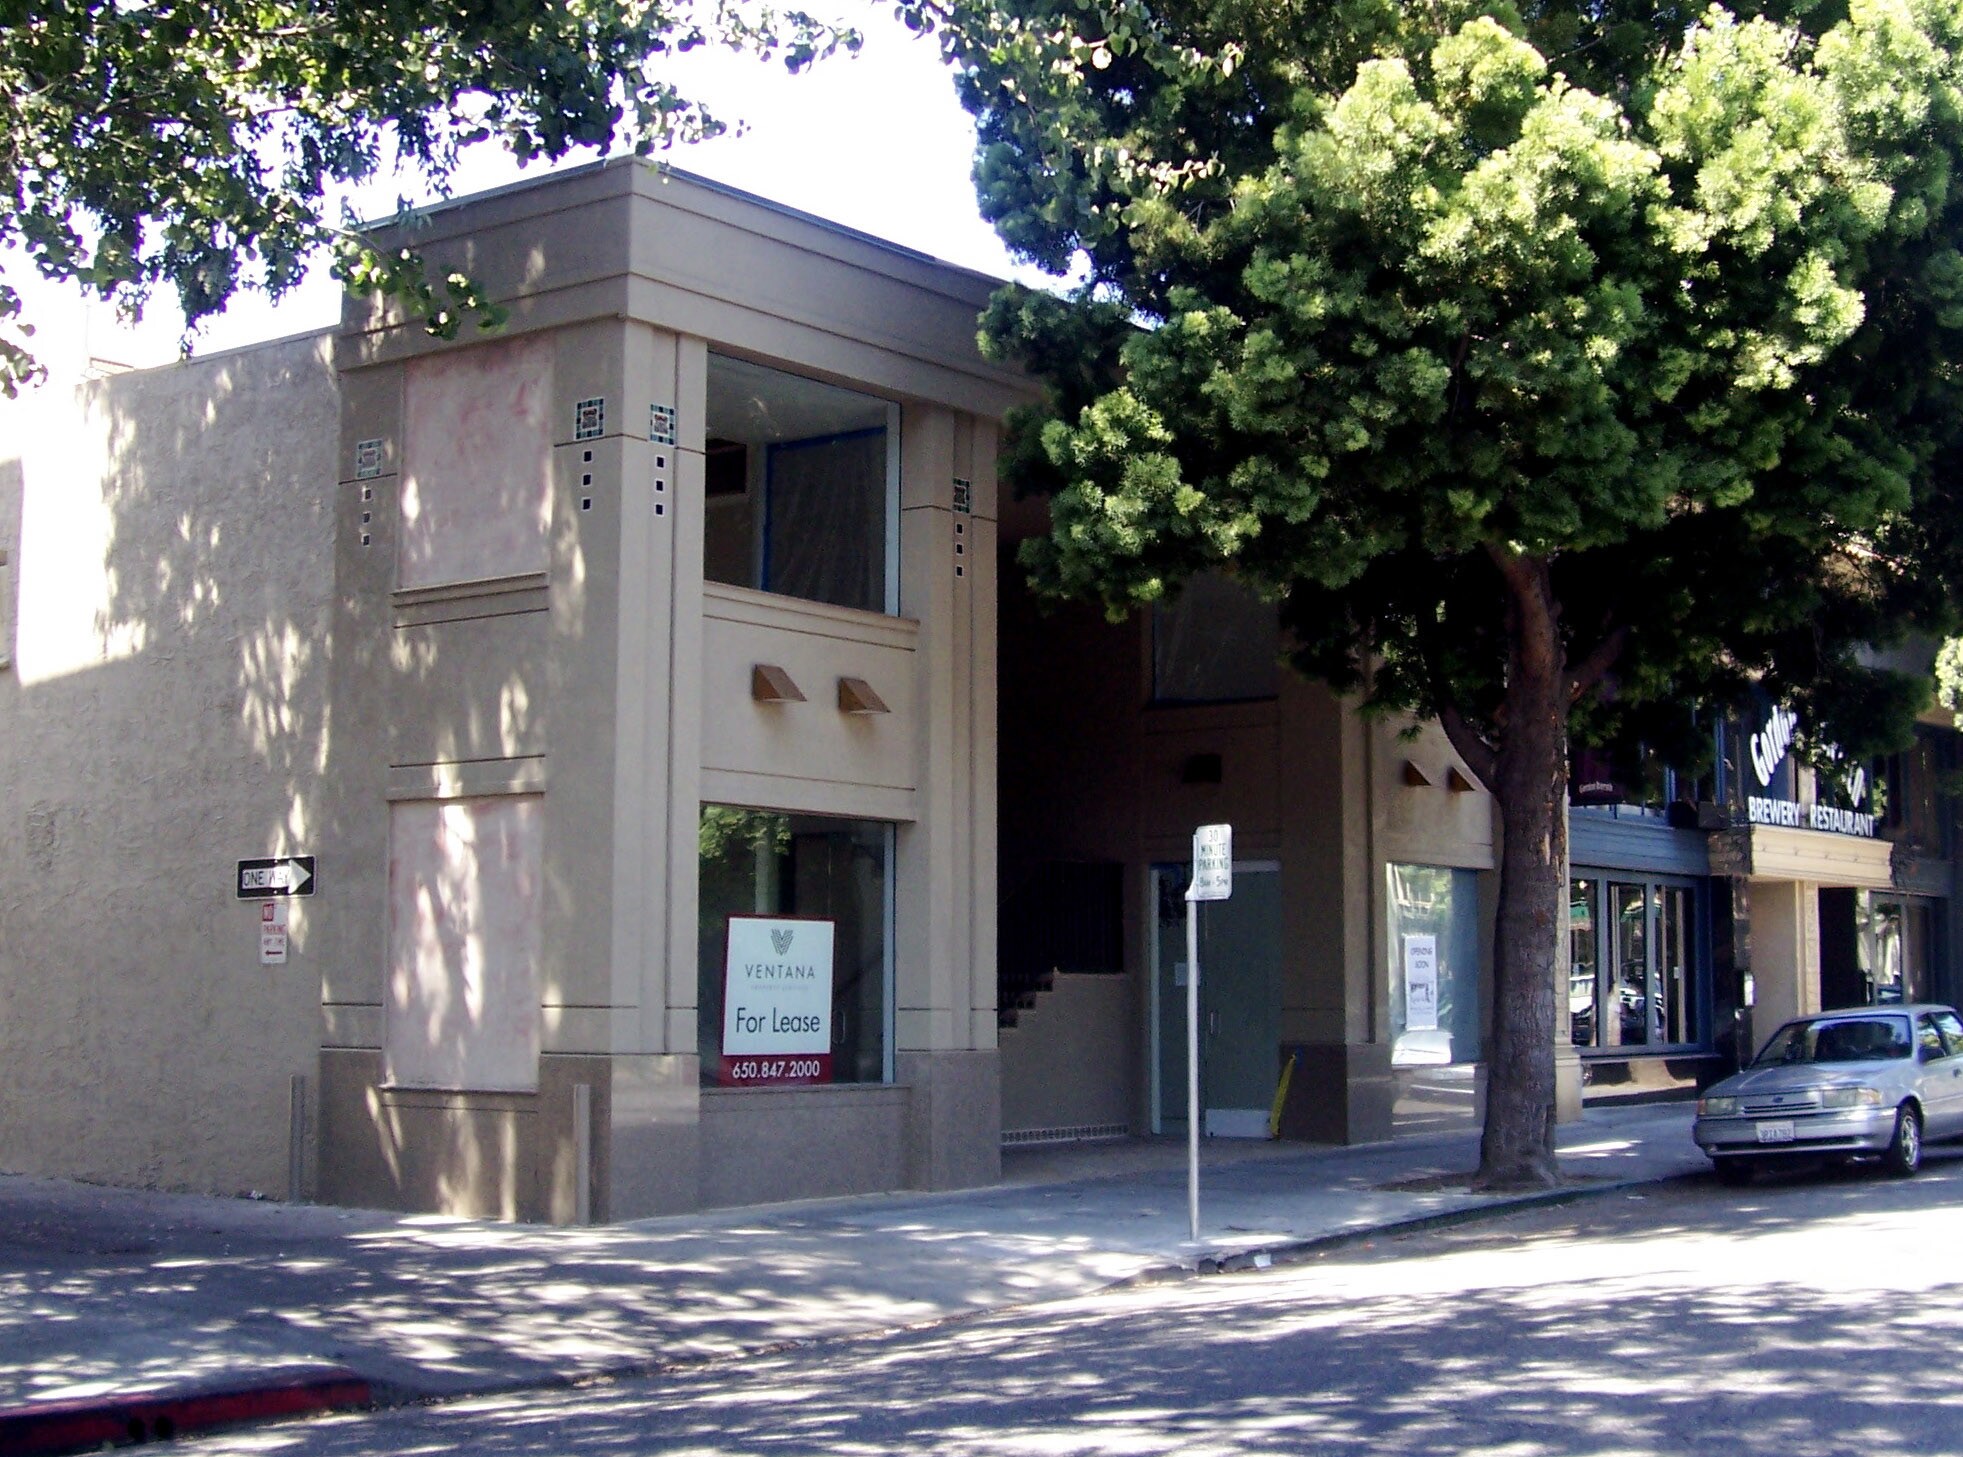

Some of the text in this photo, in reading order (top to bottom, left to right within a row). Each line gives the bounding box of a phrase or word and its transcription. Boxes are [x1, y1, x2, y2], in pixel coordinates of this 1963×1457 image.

[1749, 796, 1874, 837] BREWERY RESTAURANT
[1208, 829, 1219, 842] 30
[1200, 843, 1227, 857] MINUTE
[1198, 858, 1229, 870] PARKING
[243, 871, 264, 886] ONE
[745, 964, 815, 979] VENTANA
[736, 1007, 821, 1033] For Lease
[732, 1060, 821, 1079] 650.847.2000
